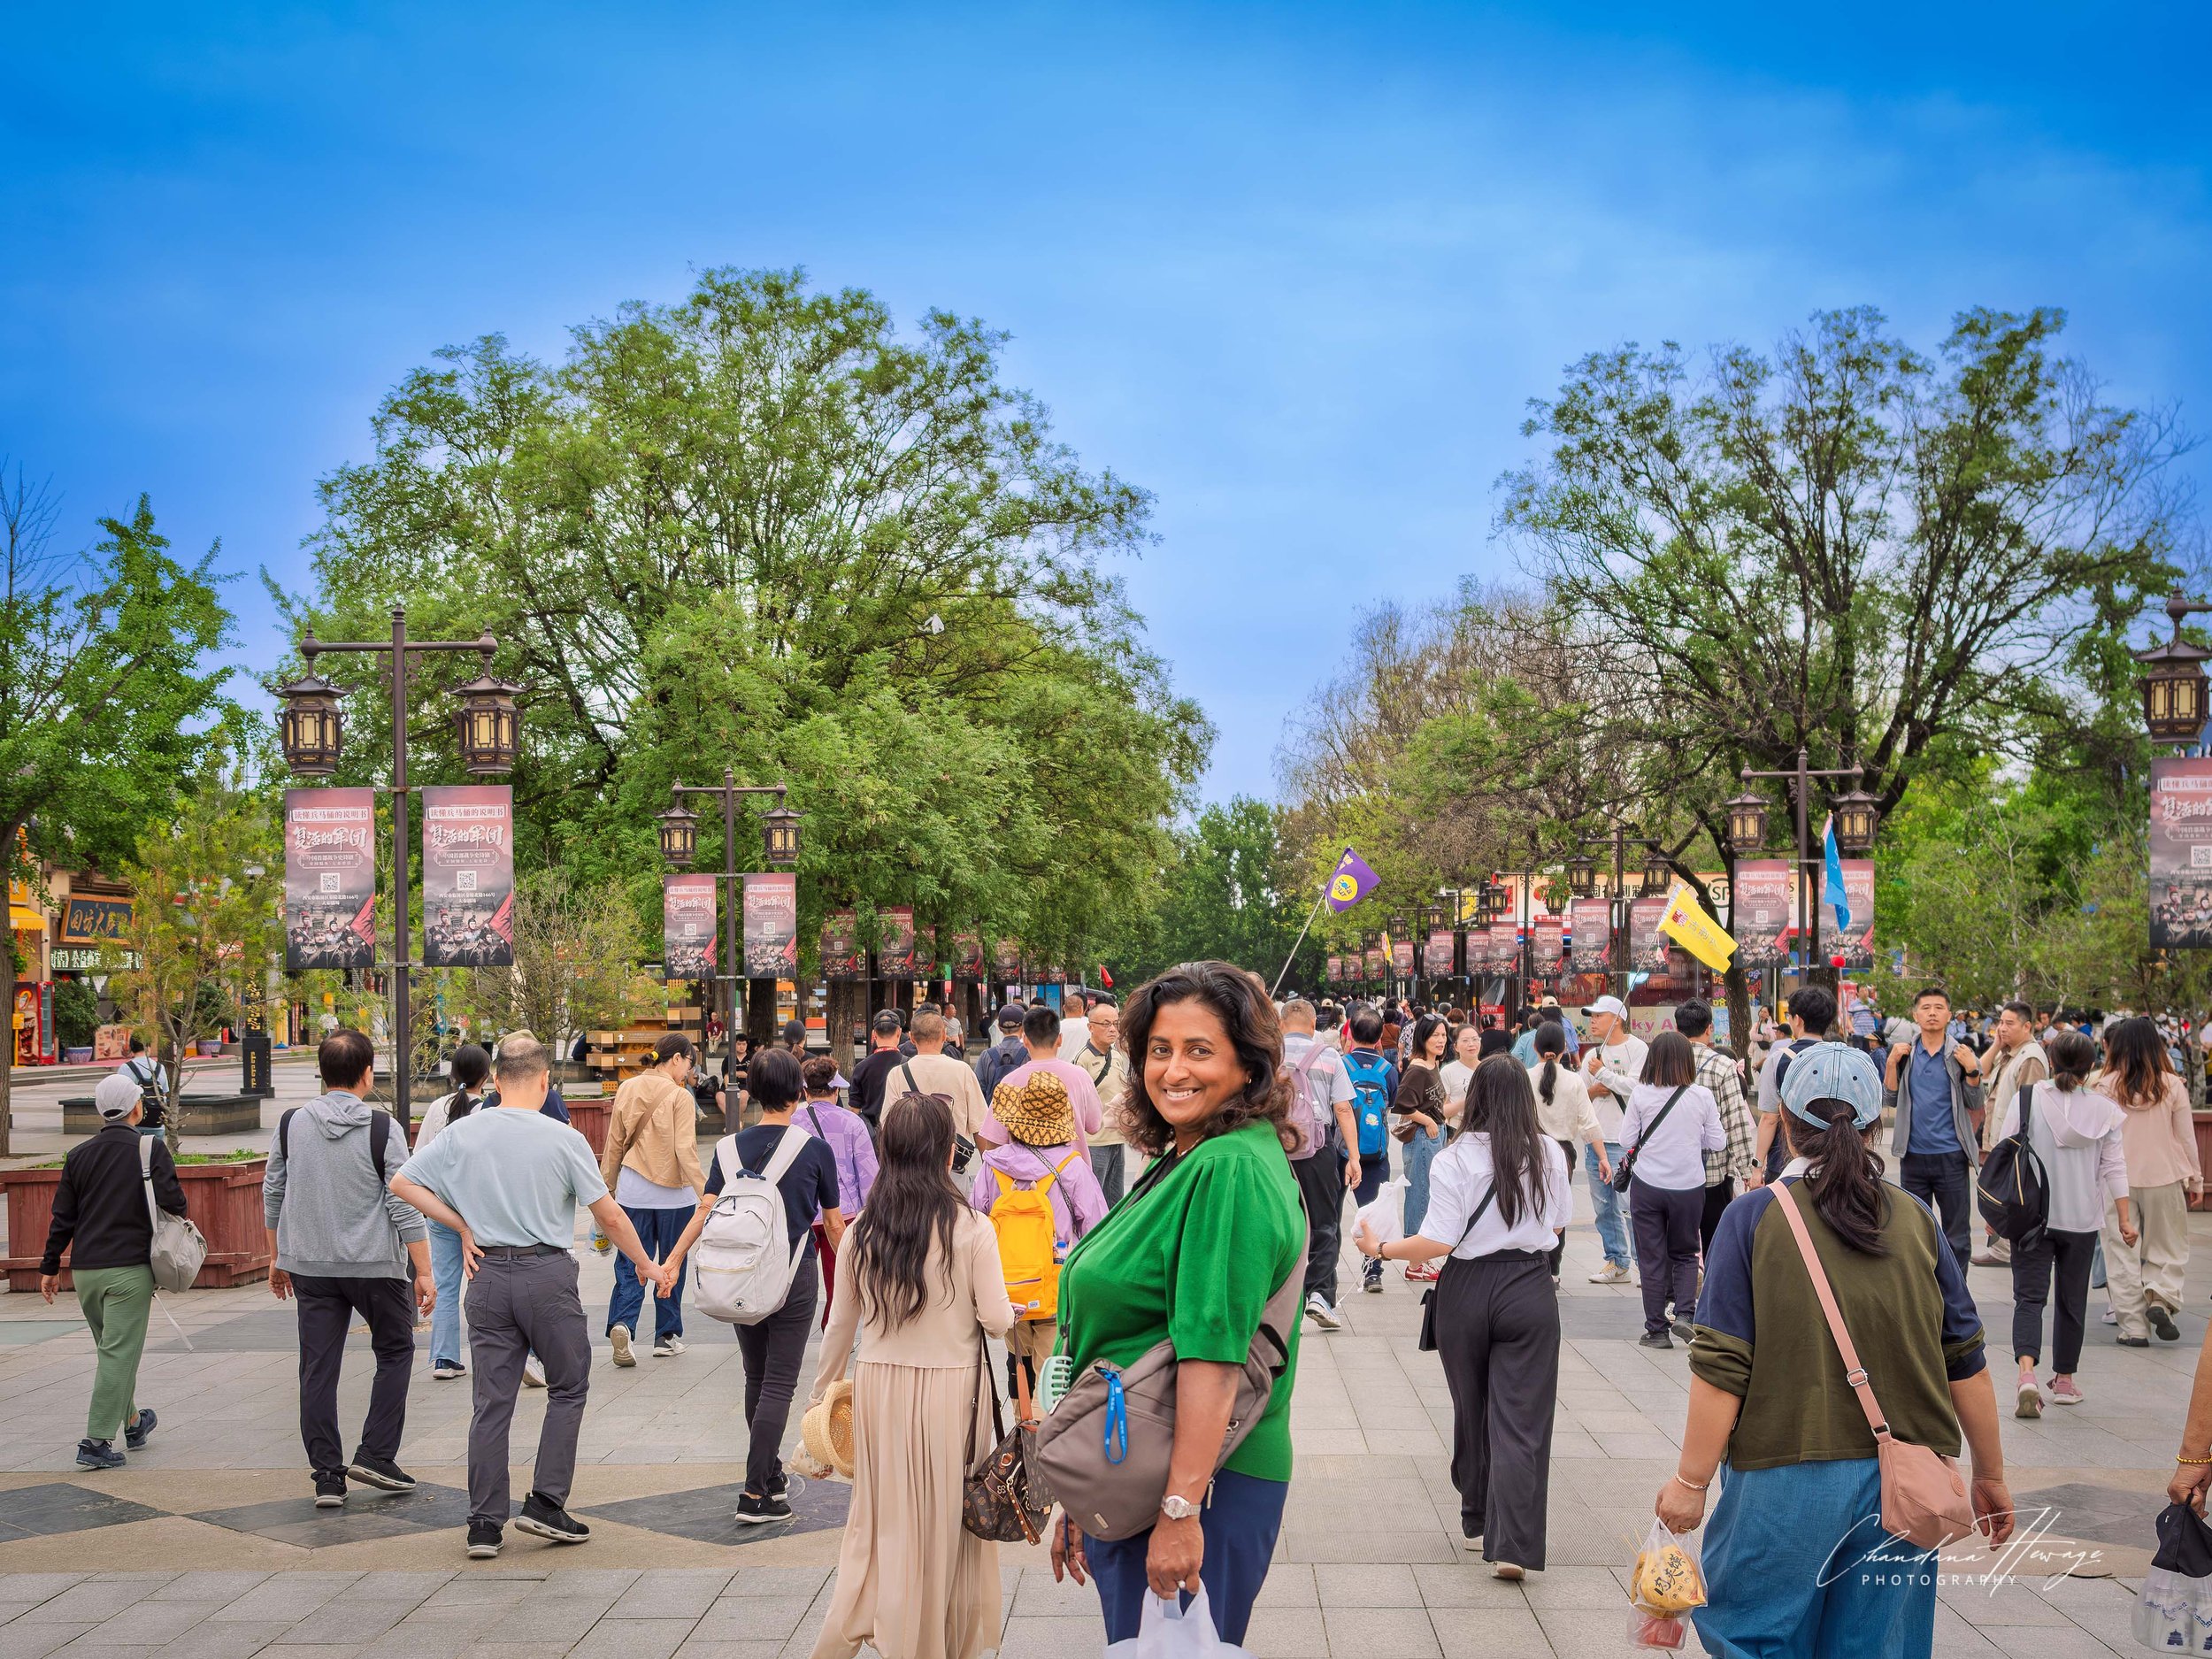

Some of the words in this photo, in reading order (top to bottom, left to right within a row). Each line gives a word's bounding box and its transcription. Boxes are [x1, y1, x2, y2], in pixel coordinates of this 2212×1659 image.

[292, 826, 368, 851] 复活的军团
[429, 823, 503, 849] 复活的军团
